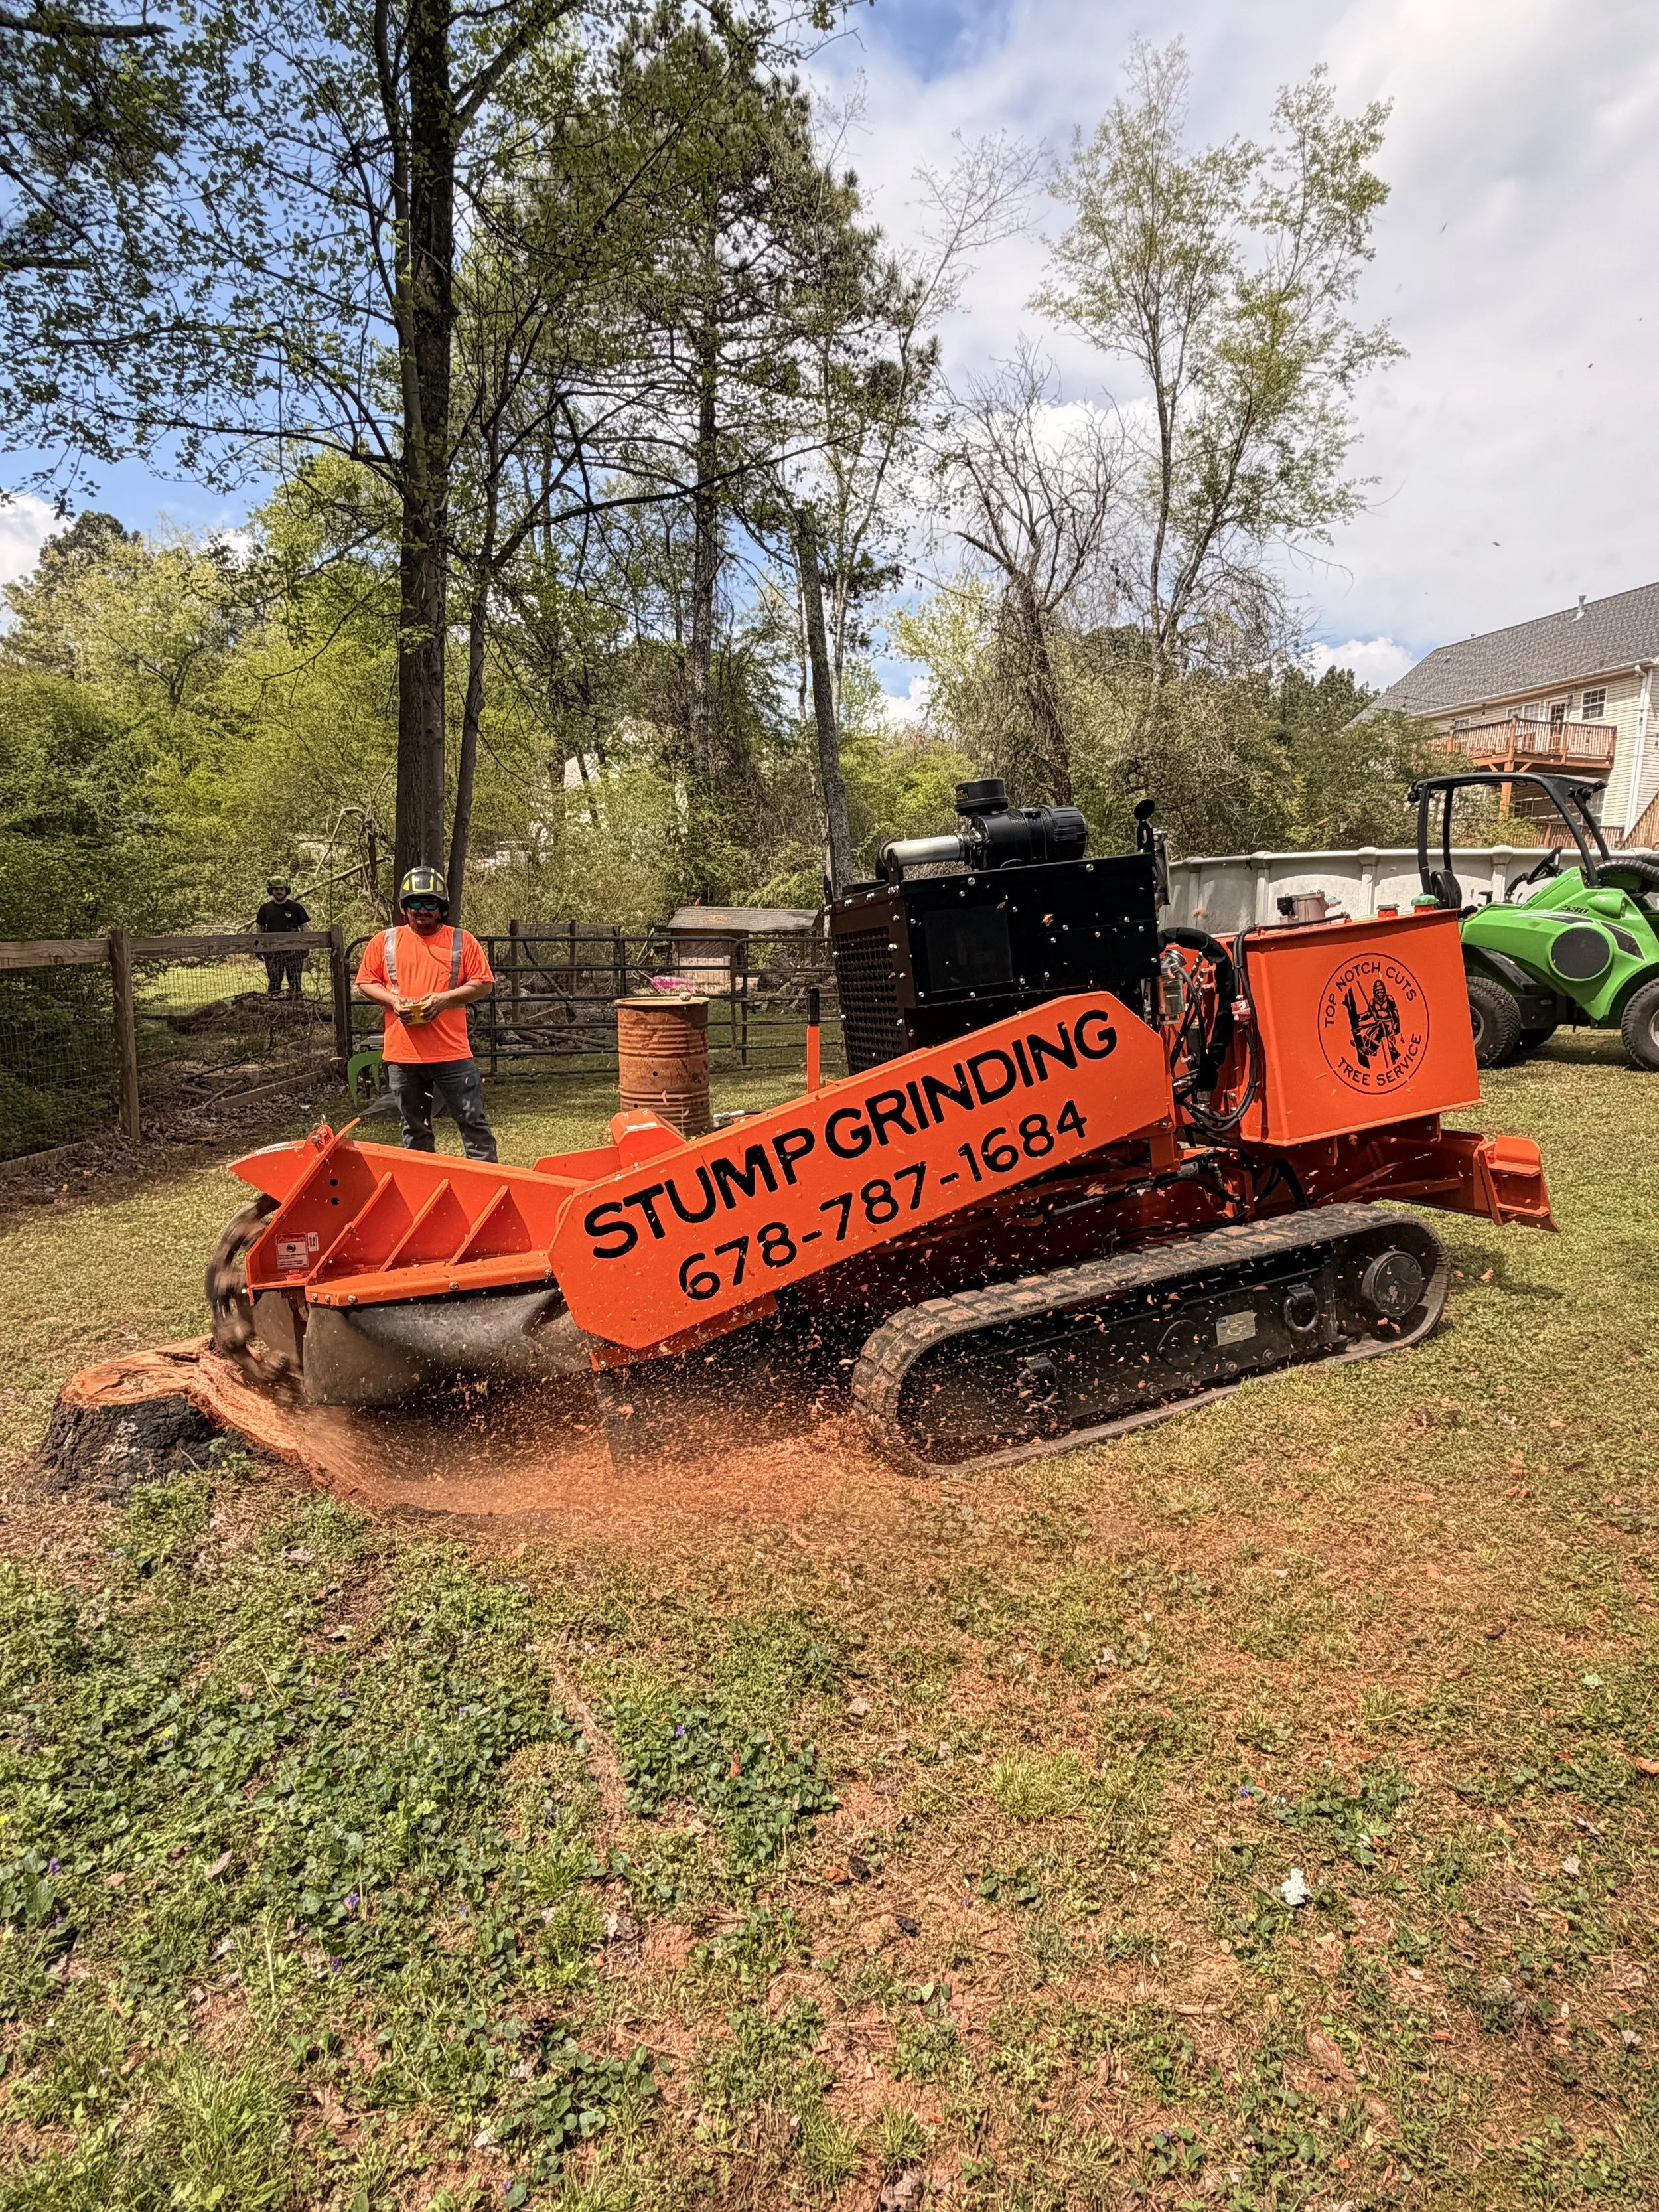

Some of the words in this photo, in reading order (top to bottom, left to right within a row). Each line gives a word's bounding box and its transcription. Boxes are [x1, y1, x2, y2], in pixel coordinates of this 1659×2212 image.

[1324, 993, 1337, 1028] TOP
[1335, 961, 1381, 992] NOTCH
[1385, 966, 1417, 1001] CUTS
[1338, 1056, 1370, 1086] TREE
[1376, 1033, 1421, 1087] SERVICE
[584, 1128, 816, 1259] STUMP
[824, 1009, 1117, 1159] GRINDING
[678, 1100, 1088, 1301] 678-787-1684
